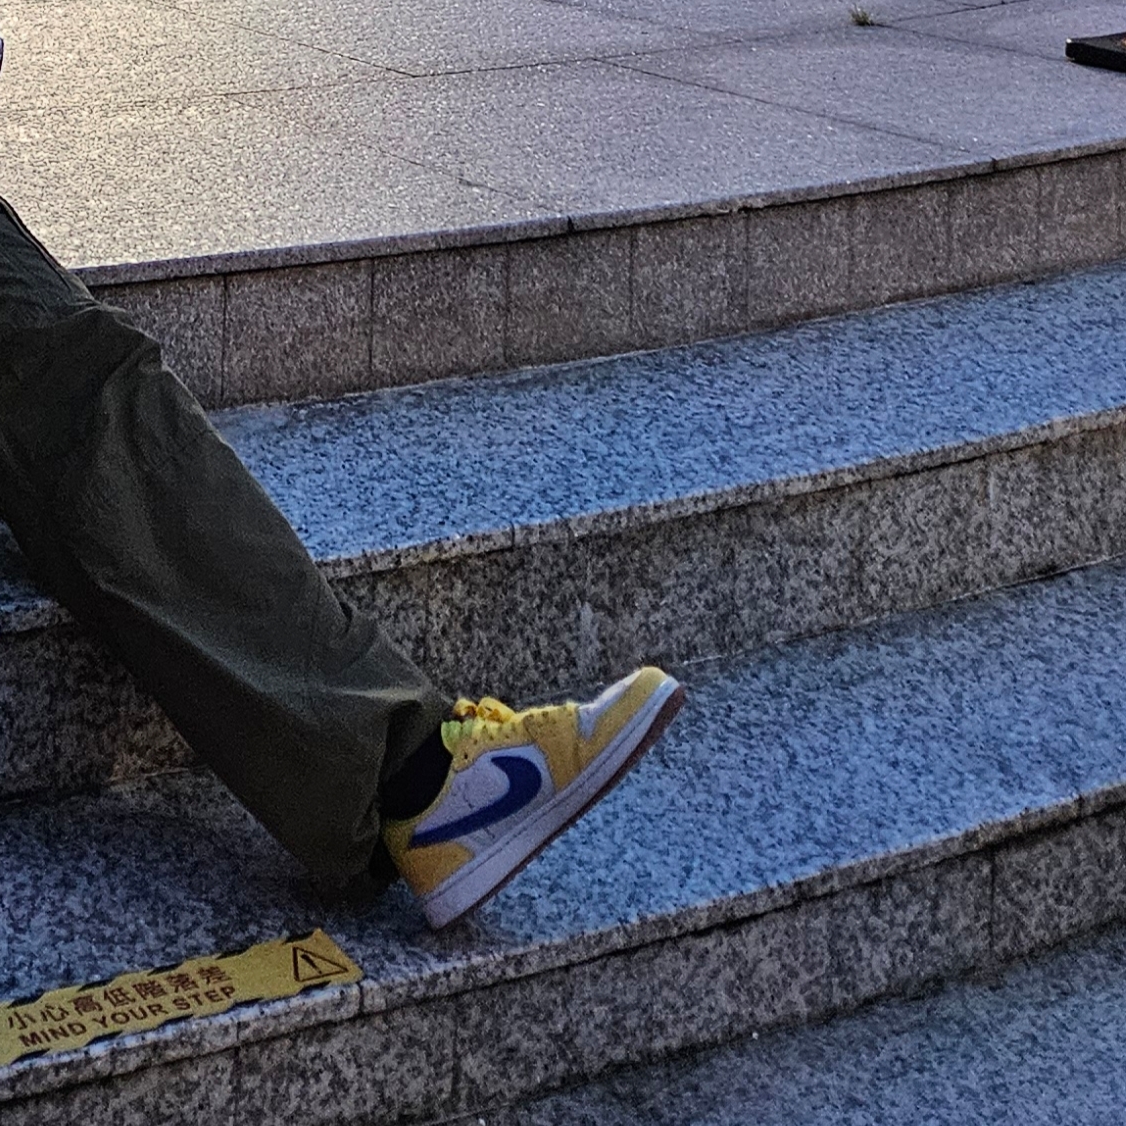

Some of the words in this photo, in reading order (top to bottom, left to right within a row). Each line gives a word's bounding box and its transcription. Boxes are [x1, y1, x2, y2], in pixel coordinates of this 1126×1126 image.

[7, 966, 232, 1030] 小心高低階落差
[18, 1023, 87, 1048] MIND
[92, 1003, 169, 1028] YOUR
[173, 985, 236, 1012] STEP
